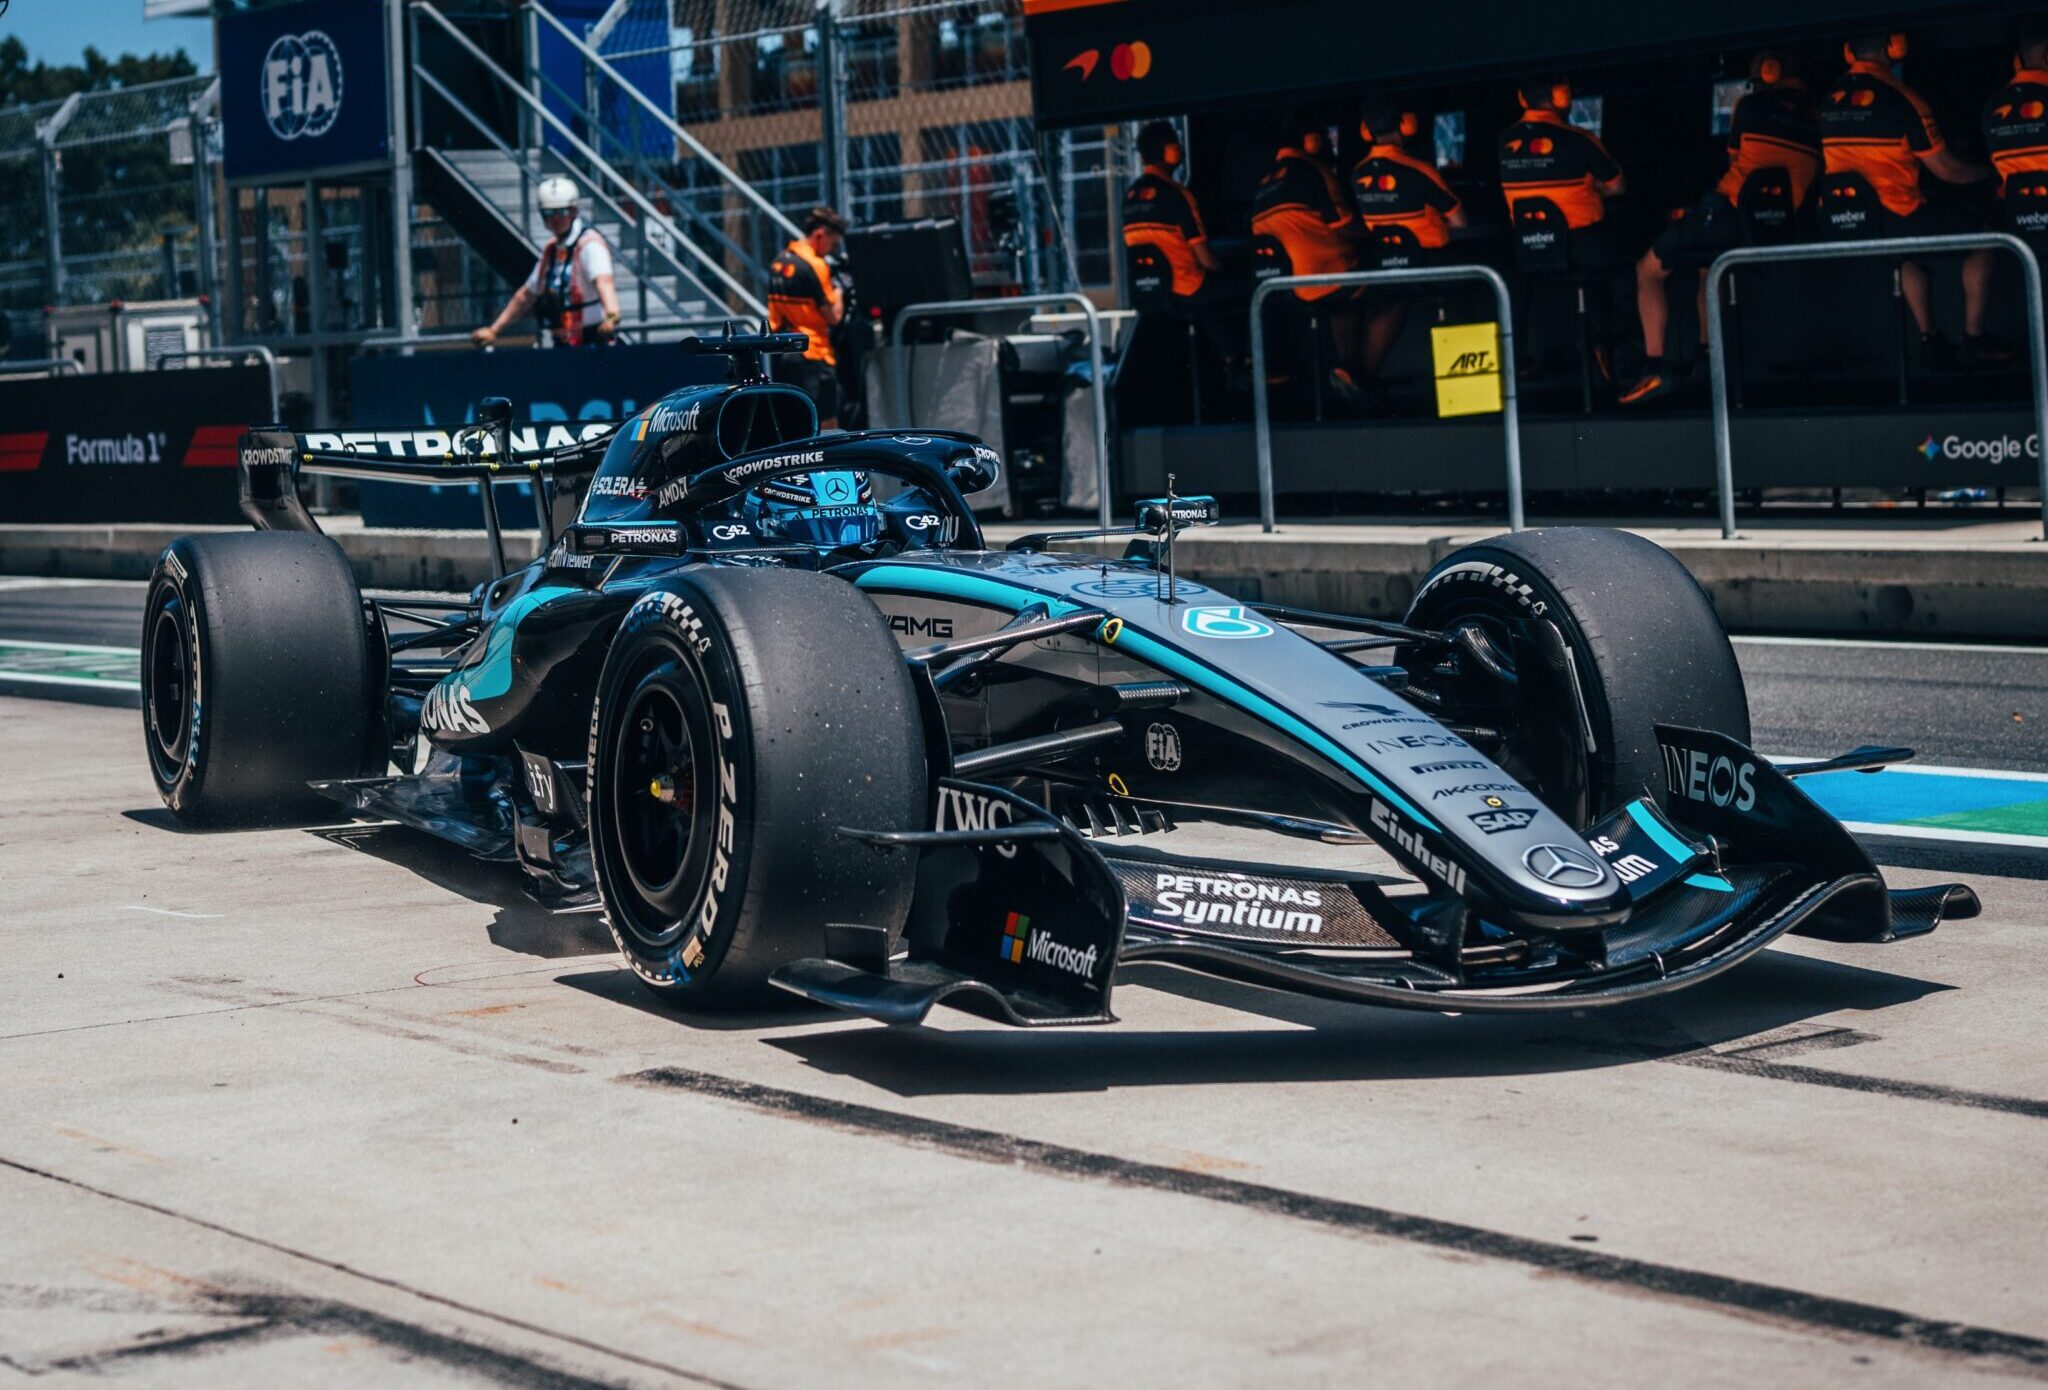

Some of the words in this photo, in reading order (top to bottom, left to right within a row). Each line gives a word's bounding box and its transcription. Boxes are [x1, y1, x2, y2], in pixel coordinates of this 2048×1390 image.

[1831, 210, 1866, 224] webex
[2016, 211, 2048, 226] webe
[1522, 231, 1555, 244] webex
[1450, 350, 1490, 371] ART
[650, 402, 700, 432] Microsoft
[66, 434, 144, 465] Formula
[1943, 435, 2021, 465] Google
[729, 451, 824, 480] CROWDSTRIKE
[595, 477, 636, 496] SOLERA
[764, 487, 811, 504] CROWDSTRIKE
[812, 506, 869, 519] PETRONAS
[1166, 509, 1207, 519] ETRONAS
[611, 533, 677, 543] PETRONAS
[888, 614, 953, 639] AMG
[1341, 717, 1436, 730] CROWDSTRIKE
[1366, 735, 1469, 754] INEOS
[1661, 744, 1756, 811] INEOS
[1432, 783, 1528, 800] AKKODIS
[935, 786, 1017, 858] IWC
[1473, 811, 1533, 832] SAP
[701, 762, 736, 937] ZERO
[1370, 797, 1466, 896] Einhell
[1156, 873, 1322, 907] PETRONAS
[1153, 892, 1323, 934] Syntium
[1027, 928, 1098, 978] Microsoft
